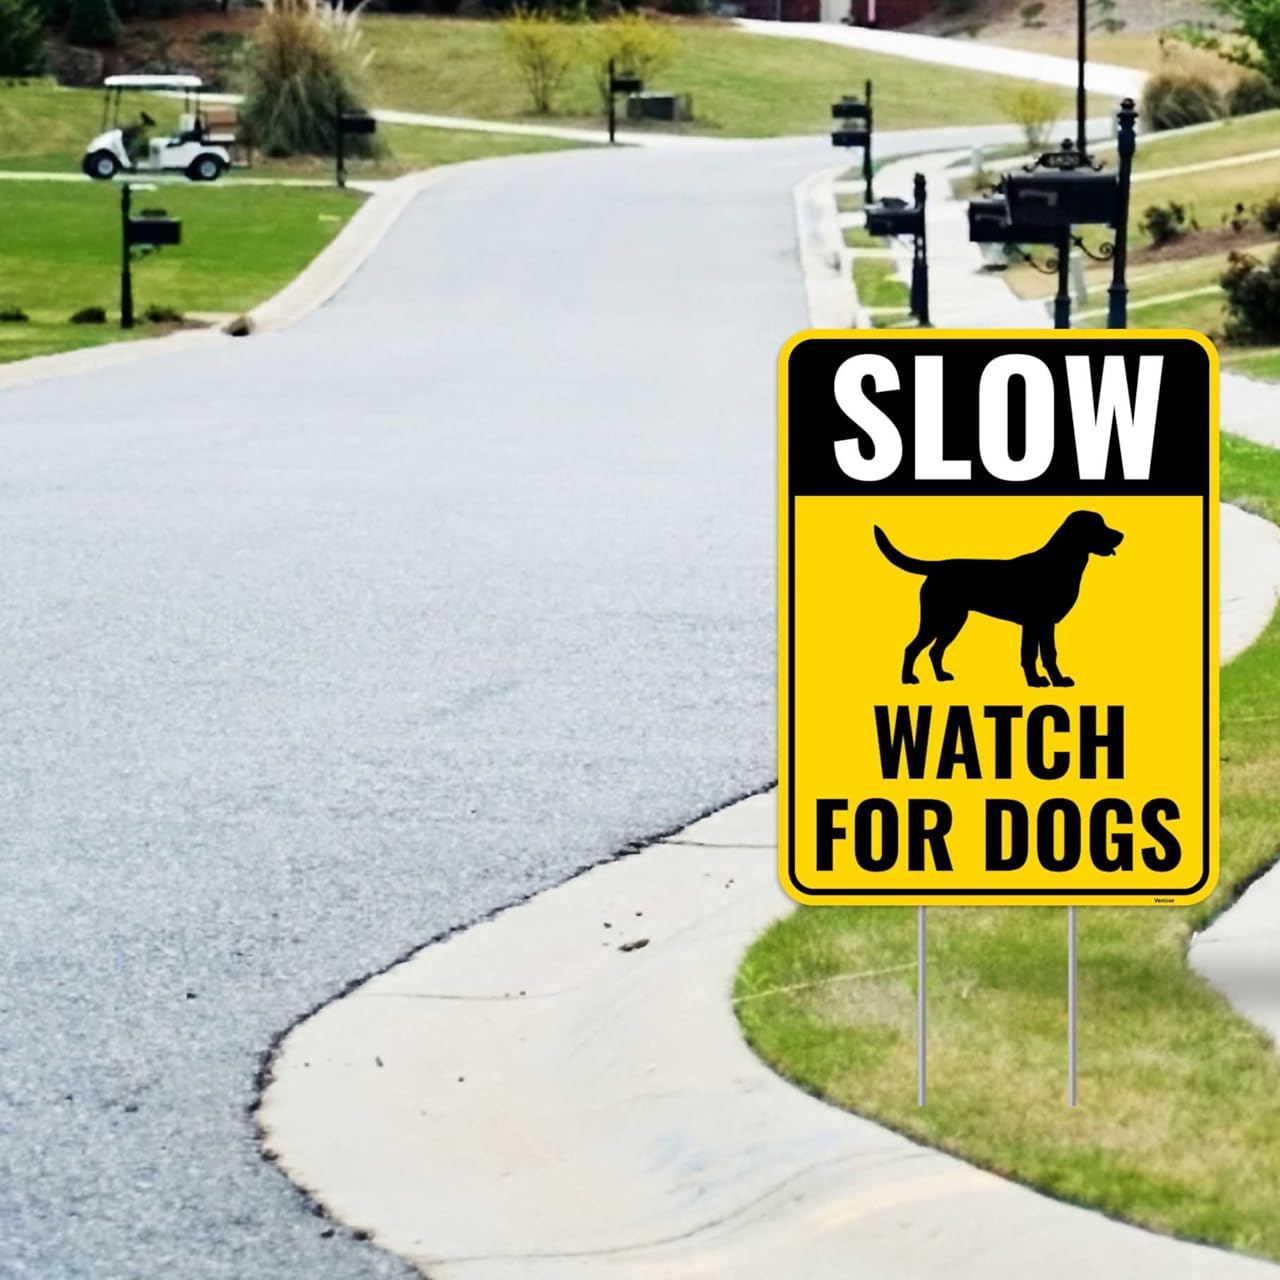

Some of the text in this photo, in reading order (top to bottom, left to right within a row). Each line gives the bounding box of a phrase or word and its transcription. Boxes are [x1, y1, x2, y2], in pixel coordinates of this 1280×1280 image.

[833, 353, 1164, 482] SLOW
[873, 704, 1125, 781] WATCH
[815, 797, 1182, 873] FOR DOGS
